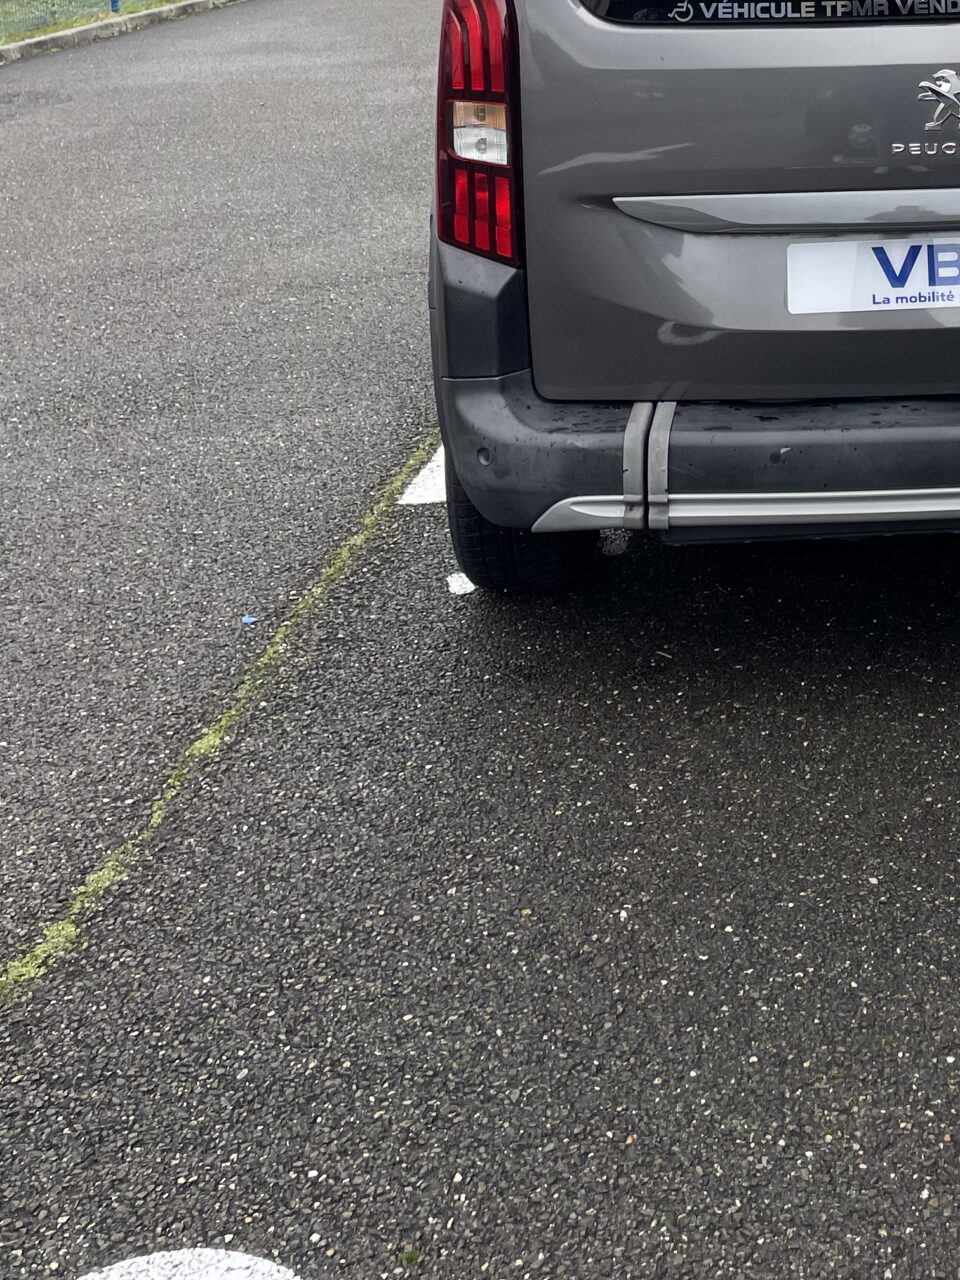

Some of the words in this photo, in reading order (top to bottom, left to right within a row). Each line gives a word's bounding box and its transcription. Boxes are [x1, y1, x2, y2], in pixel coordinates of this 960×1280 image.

[821, 0, 890, 17] TPMR
[872, 293, 891, 305] La
[895, 290, 955, 305] mobilité
